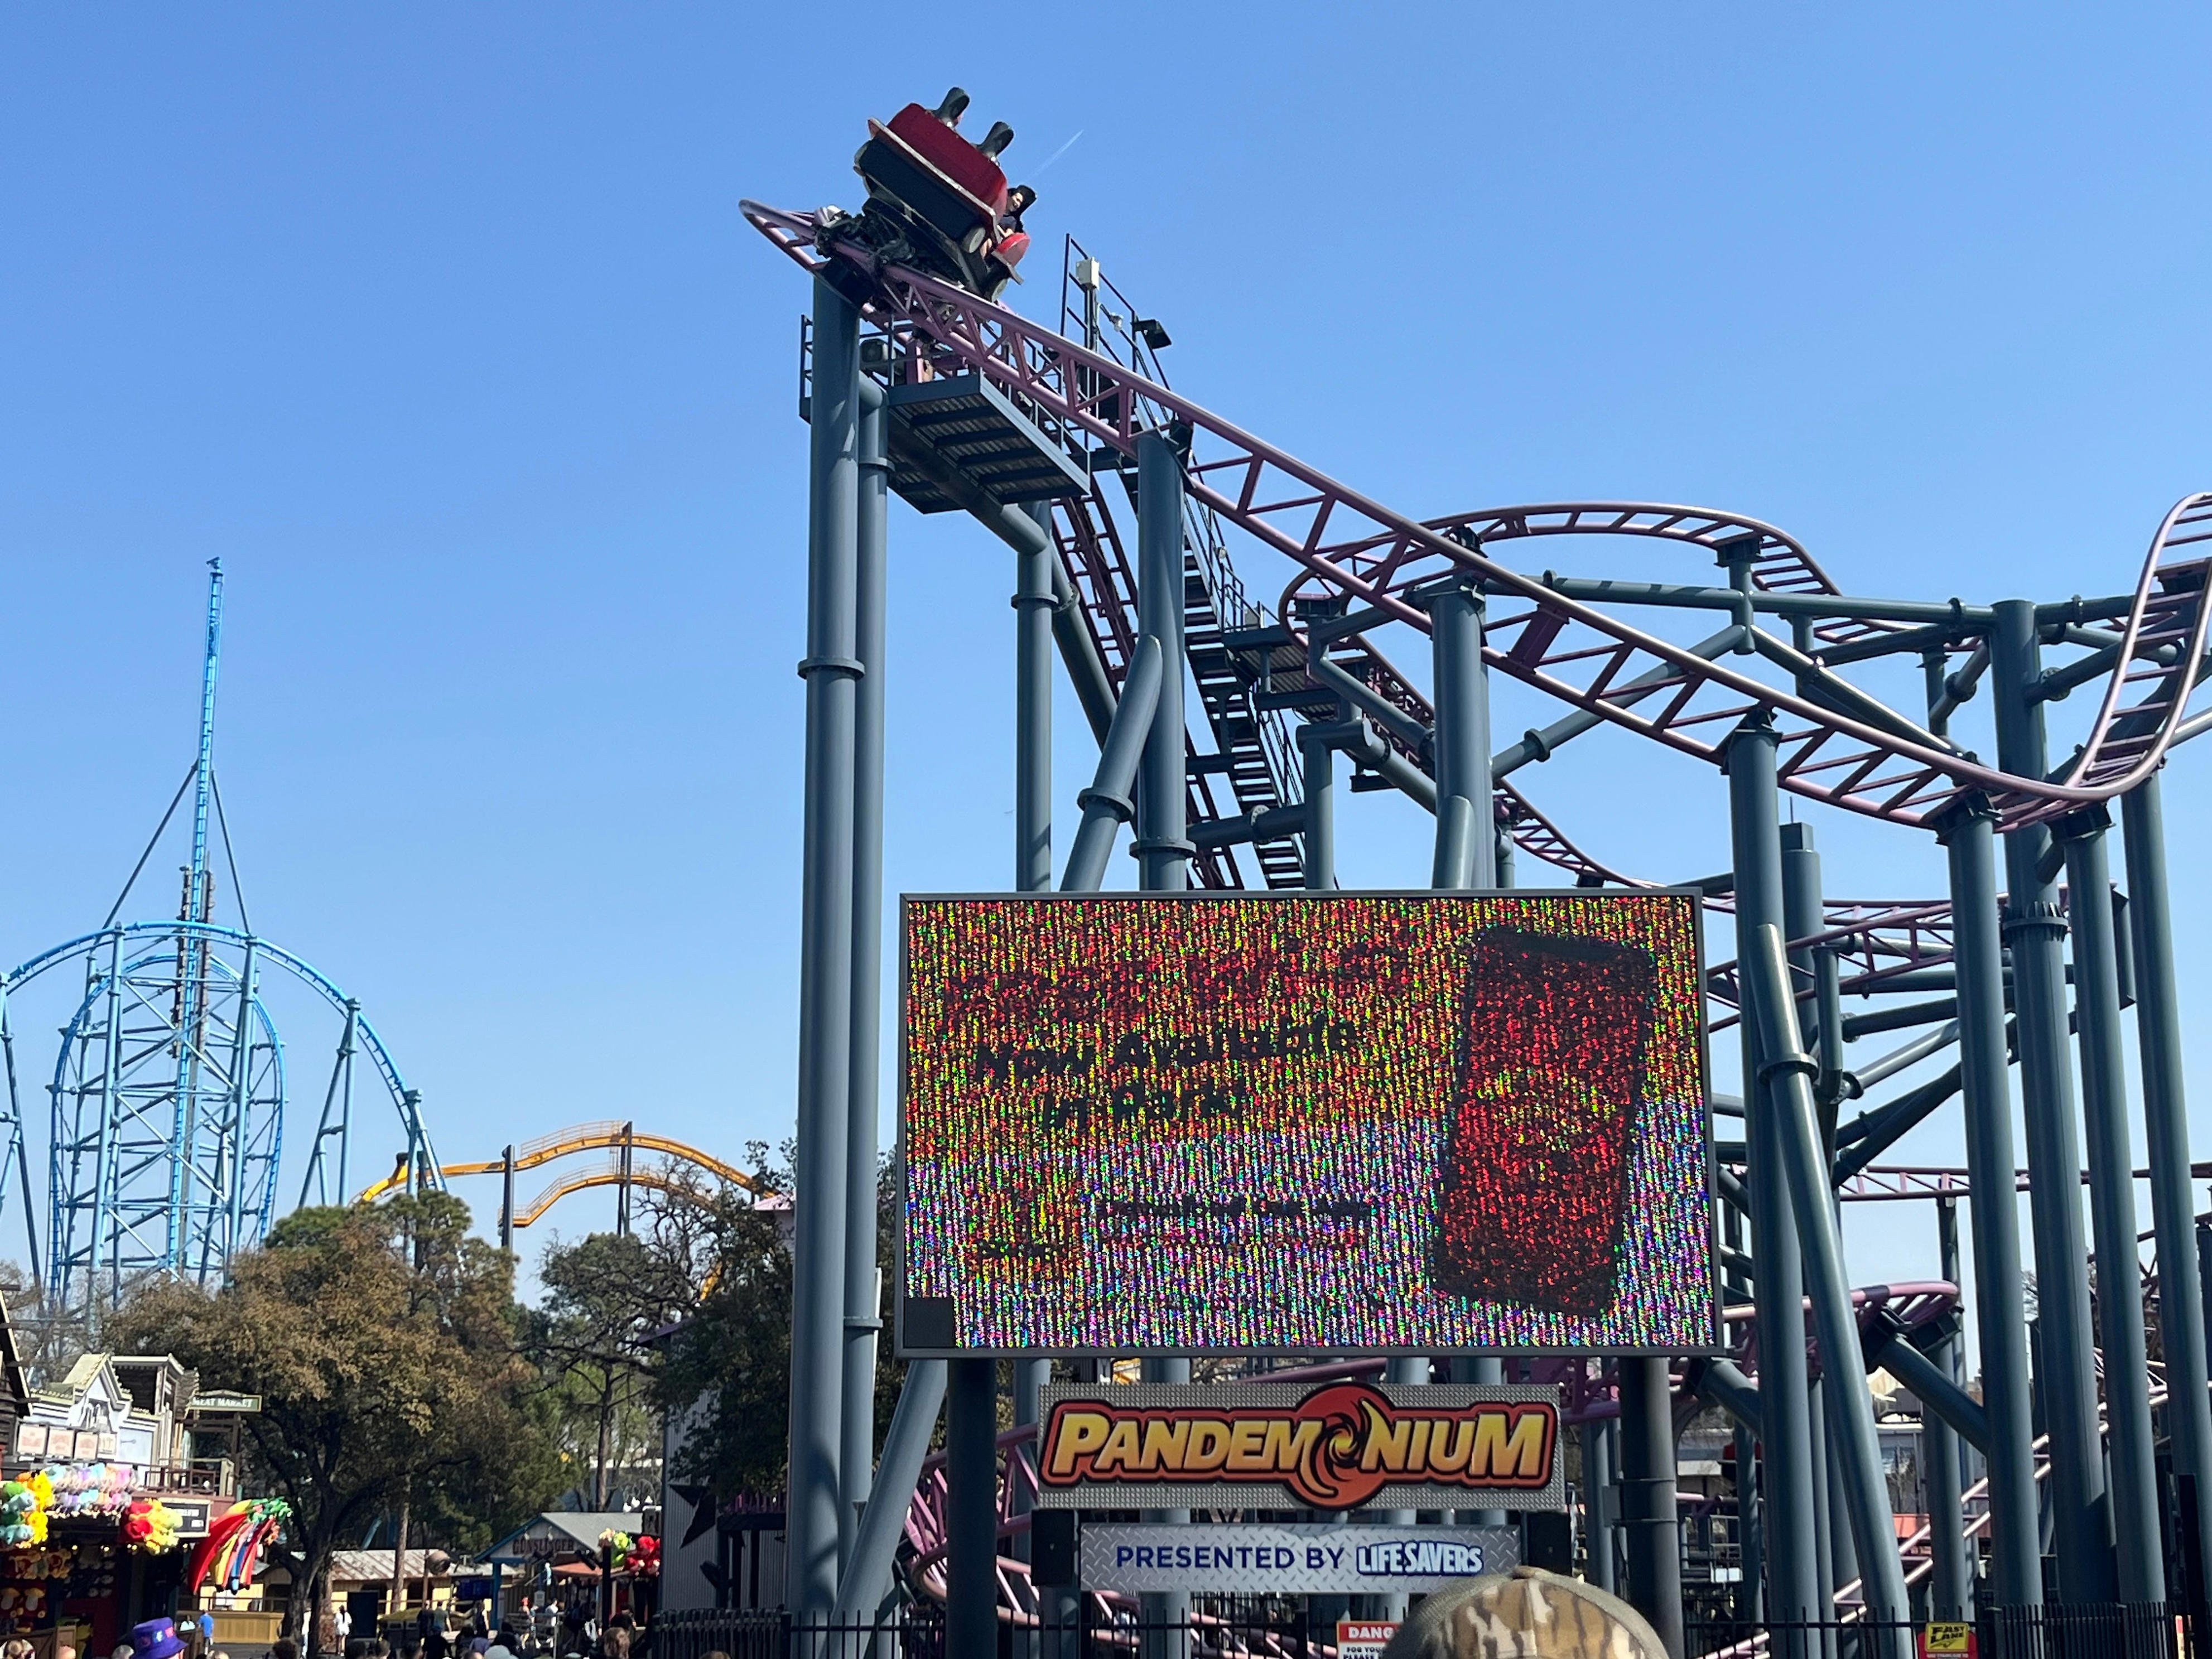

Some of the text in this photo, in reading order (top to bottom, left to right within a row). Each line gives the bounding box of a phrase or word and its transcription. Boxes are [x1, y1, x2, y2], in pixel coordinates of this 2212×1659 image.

[974, 1014, 1357, 1085] Now Available
[191, 1397, 253, 1407] MEAT MARKET
[1052, 1398, 1544, 1494] PANDEMONIUM
[513, 1537, 574, 1555] GUNSLINGER
[1116, 1546, 1295, 1569] PRESENTED
[1306, 1547, 1344, 1569] BY
[1348, 1627, 1394, 1639] DANG
